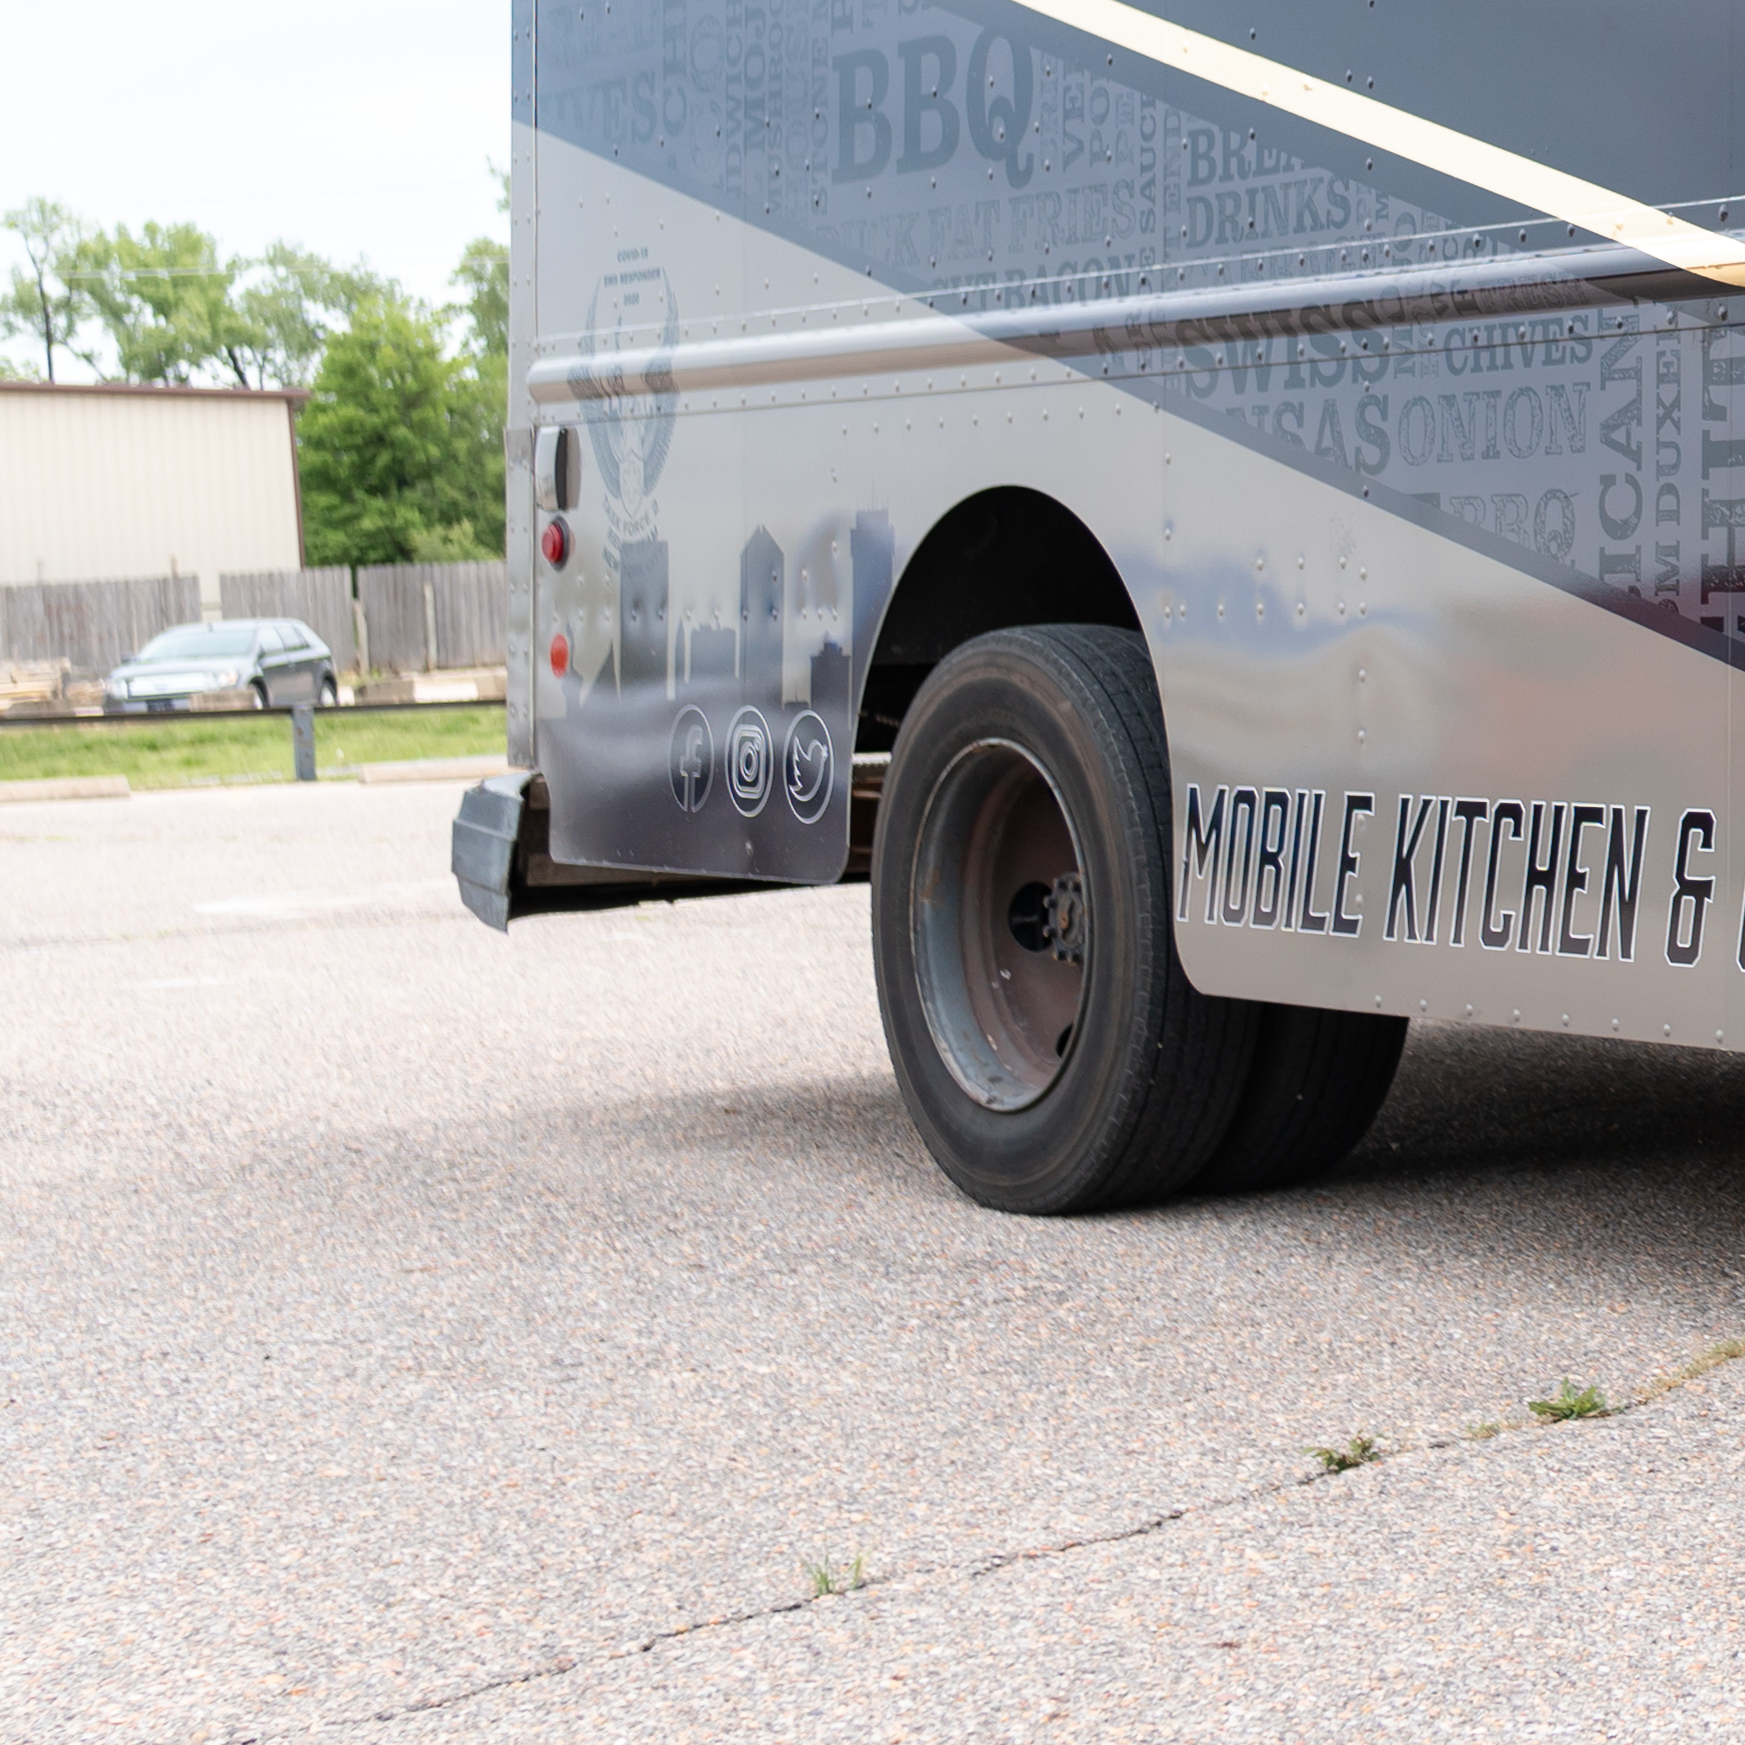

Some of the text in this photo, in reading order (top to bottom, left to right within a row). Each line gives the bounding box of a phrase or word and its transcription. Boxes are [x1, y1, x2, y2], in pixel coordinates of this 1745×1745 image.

[811, 36, 829, 216] STONE
[831, 24, 1034, 190] BBQ
[927, 199, 1001, 260] FAT
[1006, 177, 1137, 255] FRIES
[1186, 176, 1351, 250] DRINKS
[1003, 253, 1137, 310] BACON
[1444, 313, 1594, 377] CHIVES
[1398, 381, 1592, 468] ONION
[1175, 783, 1375, 938] MOBILE
[1383, 794, 1651, 963] KITCHEN
[1664, 808, 1716, 968] &
